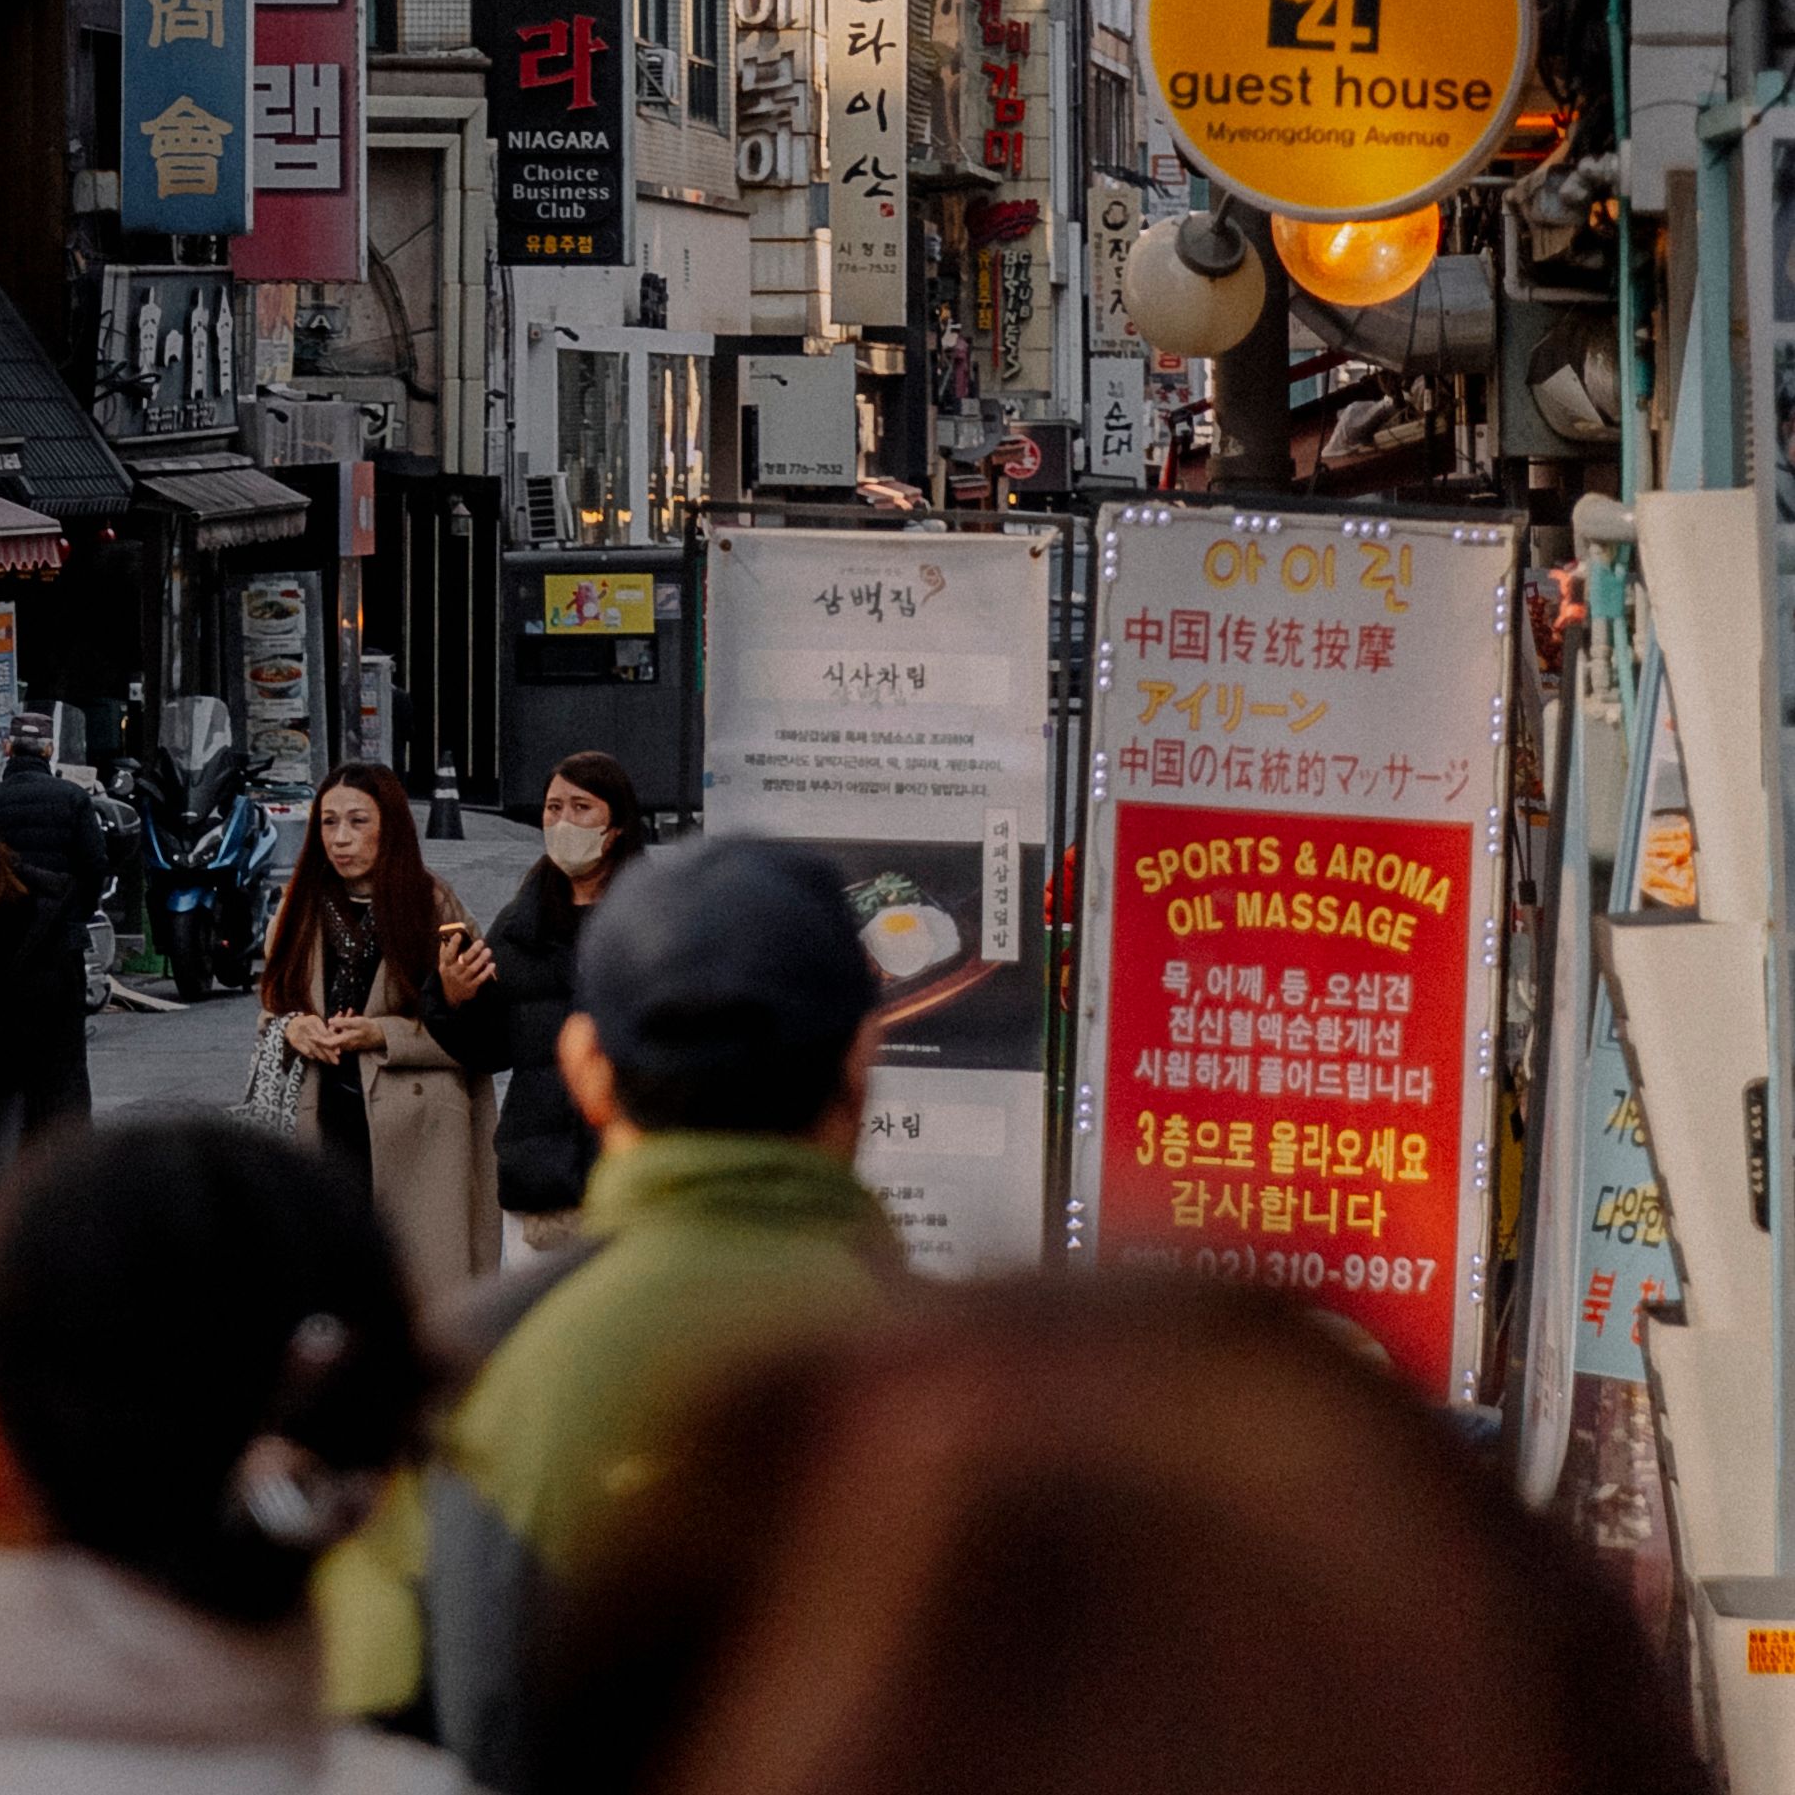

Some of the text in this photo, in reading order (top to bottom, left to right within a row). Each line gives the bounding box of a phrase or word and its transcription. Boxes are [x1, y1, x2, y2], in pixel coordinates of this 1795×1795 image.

[842, 18, 899, 198] 타이산
[1168, 66, 1493, 111] guest house
[508, 130, 610, 150] NIAGARA
[1206, 121, 1451, 148] Myeongdong Avenue
[512, 183, 611, 200] Business
[523, 163, 599, 182] Choice
[536, 201, 587, 219] Club
[1204, 539, 1414, 614] 아이린
[813, 581, 917, 624] 삼백집
[1123, 606, 1397, 674] 中国传统按摩
[822, 661, 926, 689] 식사차림
[1136, 679, 1330, 734] アイリーン
[1118, 734, 1470, 803] 中国の伝統的マッサージ
[1134, 835, 1452, 915] SPORTS & AROMA
[1167, 891, 1418, 953] OIL MASSAGE
[1134, 1049, 1433, 1106] 시원하게 풀어드립니다
[861, 1111, 921, 1139] 차림
[1135, 1109, 1430, 1182] 3층으로 올라오세요
[1168, 1179, 1388, 1239] 감사합니다
[1265, 1251, 1437, 1293] 310-9987
